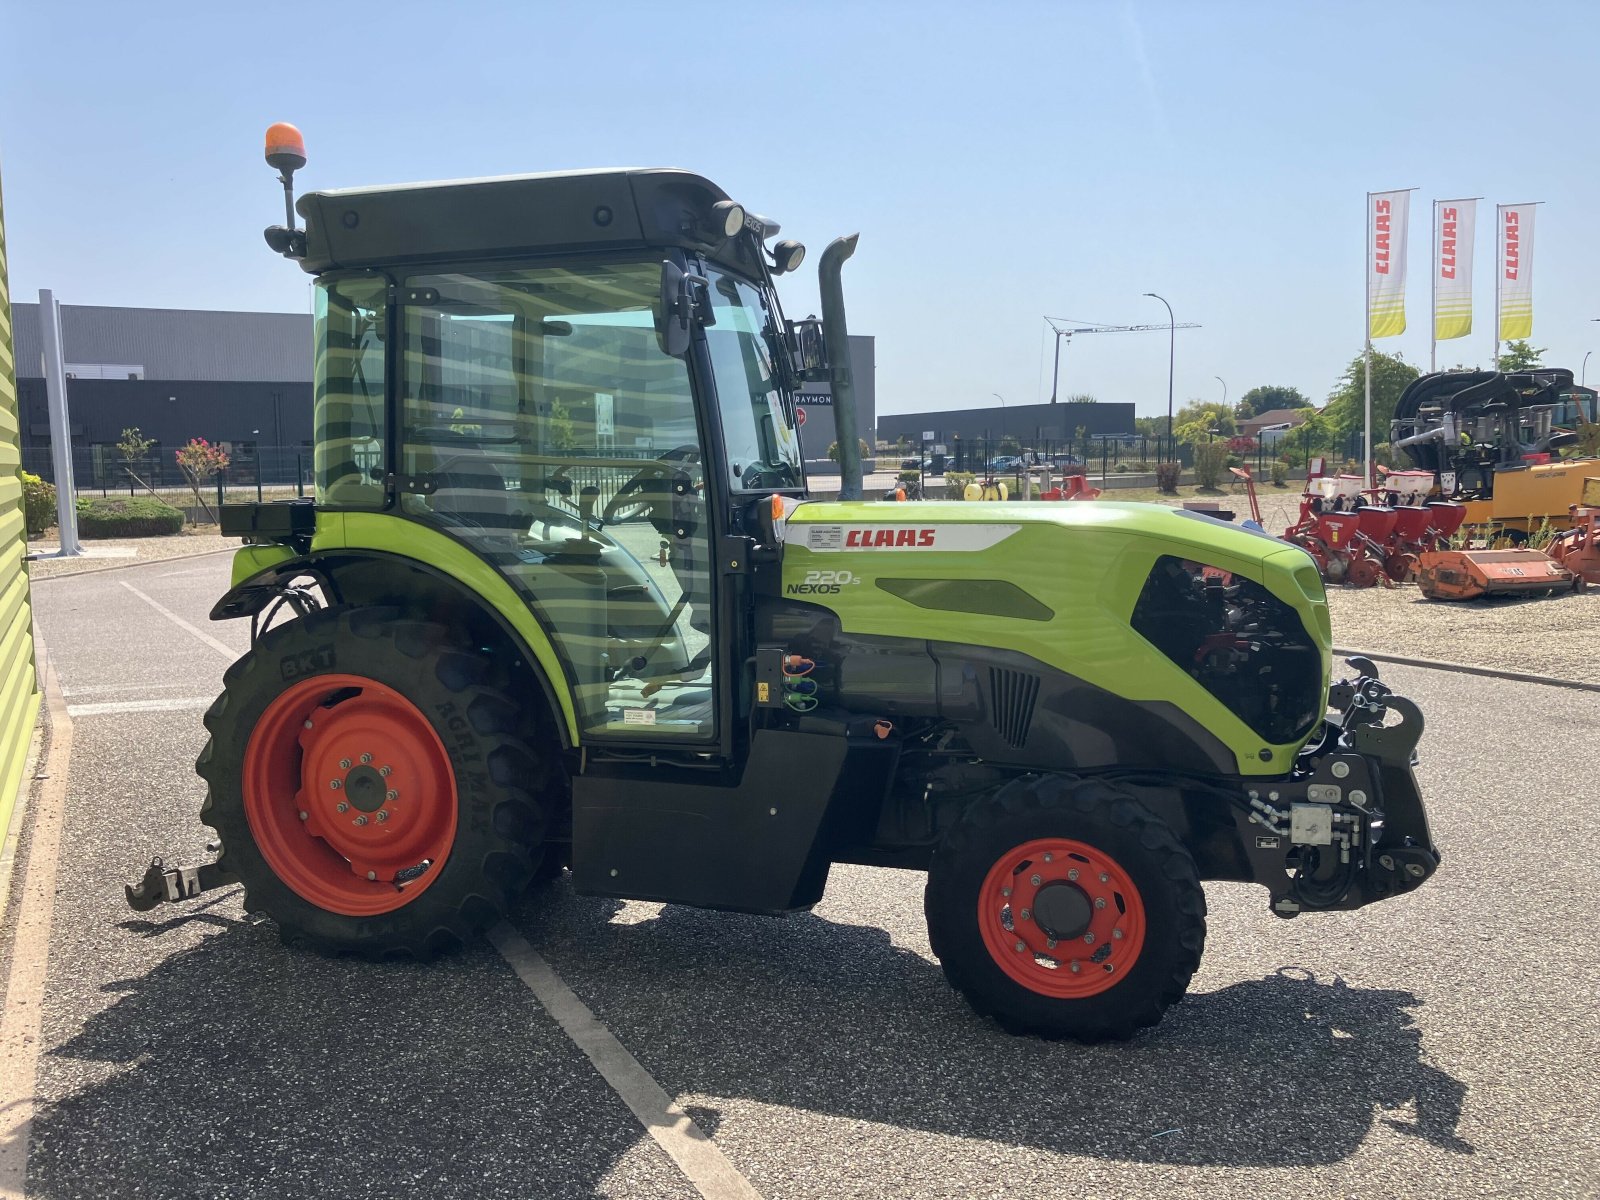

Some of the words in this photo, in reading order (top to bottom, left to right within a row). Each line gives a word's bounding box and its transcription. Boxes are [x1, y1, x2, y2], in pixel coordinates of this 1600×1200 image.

[1375, 199, 1391, 275] CLAAS
[1441, 207, 1457, 280] CLAAS
[1505, 211, 1519, 281] CLAAS
[845, 529, 936, 547] CLAAS
[786, 583, 841, 594] NEXOS
[280, 643, 335, 679] BKT
